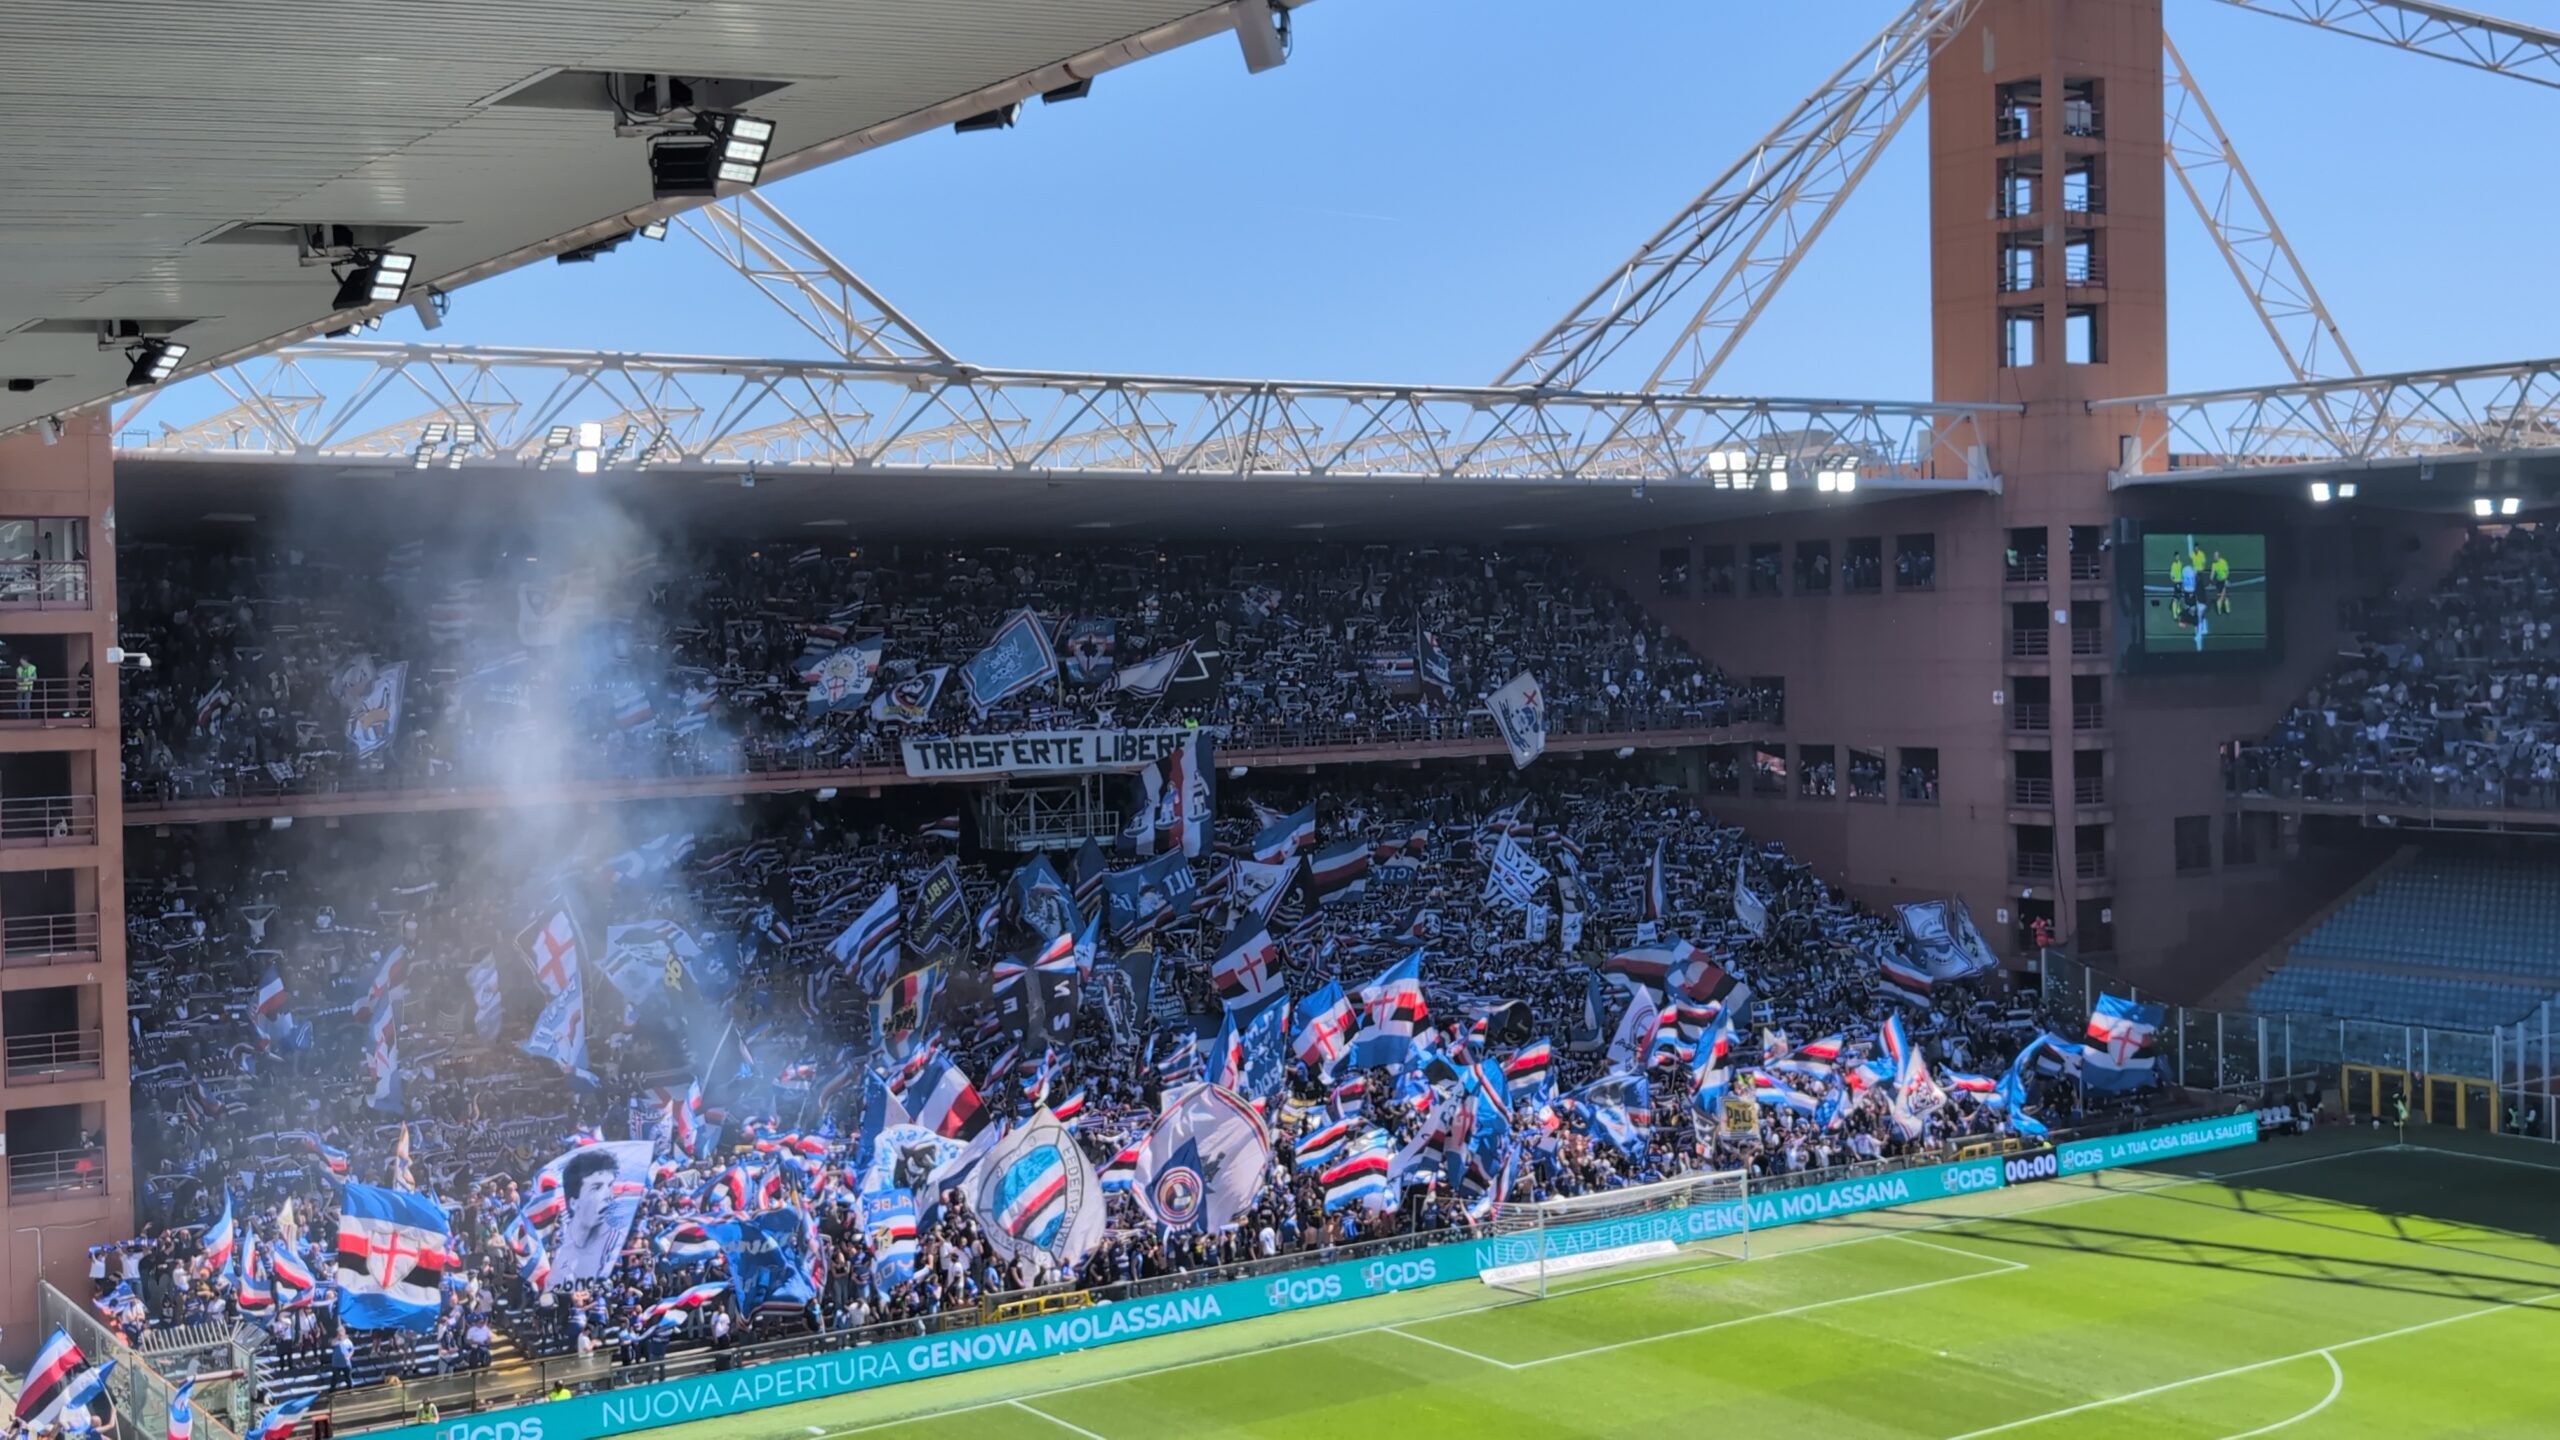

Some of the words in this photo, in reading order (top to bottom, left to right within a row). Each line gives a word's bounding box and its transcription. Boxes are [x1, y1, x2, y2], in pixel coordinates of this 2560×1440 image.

[912, 736, 1084, 770] TRASFERTE
[2073, 1148, 2103, 1168] CDS
[2110, 1143, 2127, 1158] LA
[2127, 1140, 2150, 1155] TUA
[2150, 1135, 2180, 1151] CASA
[2181, 1129, 2215, 1146] DELLA
[2215, 1121, 2254, 1142] SALUTE
[1959, 1165, 1997, 1190] CDS
[2005, 1153, 2057, 1182] 00:00
[1475, 1236, 1560, 1270] NUOVA
[1563, 1216, 1684, 1256] APERTURA
[1688, 1199, 1778, 1235] GENOVA
[1783, 1178, 1910, 1220] MOLASSANA
[1386, 1257, 1436, 1286] CDS
[1290, 1274, 1342, 1303] CDS
[602, 1386, 721, 1428] NUOVA
[730, 1352, 901, 1407] APERTURA
[907, 1327, 1038, 1373] GENOVA
[1044, 1293, 1222, 1350] MOLASSANA
